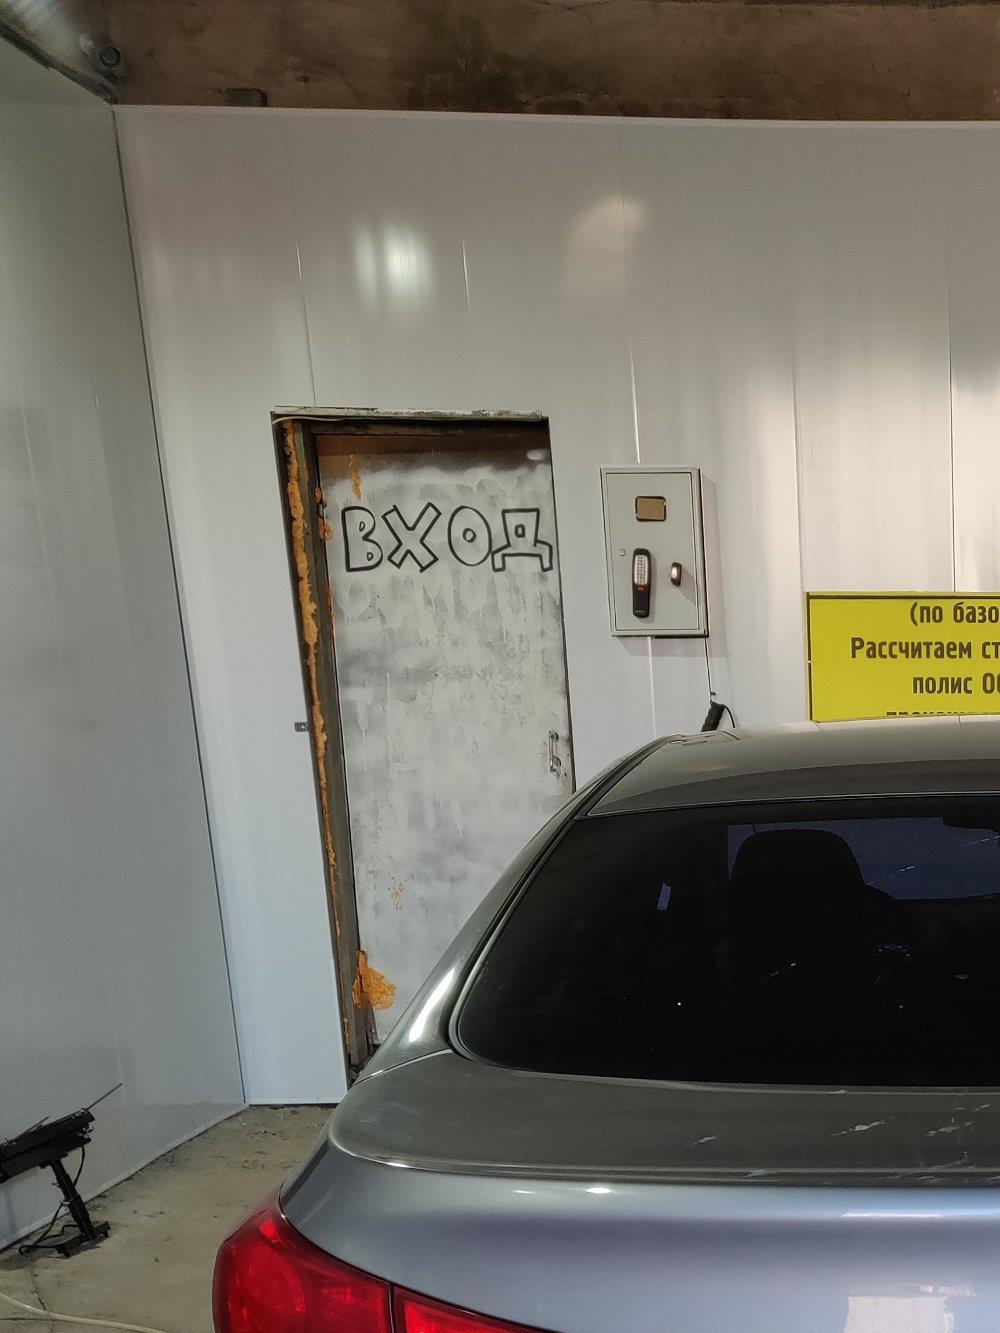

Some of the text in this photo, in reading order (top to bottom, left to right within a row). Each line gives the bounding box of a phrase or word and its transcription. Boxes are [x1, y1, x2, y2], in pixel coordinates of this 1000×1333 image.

[341, 502, 553, 573] ВХОД
[910, 601, 943, 626] (по
[851, 636, 972, 660] Рассчитаем
[912, 676, 973, 695] полис
